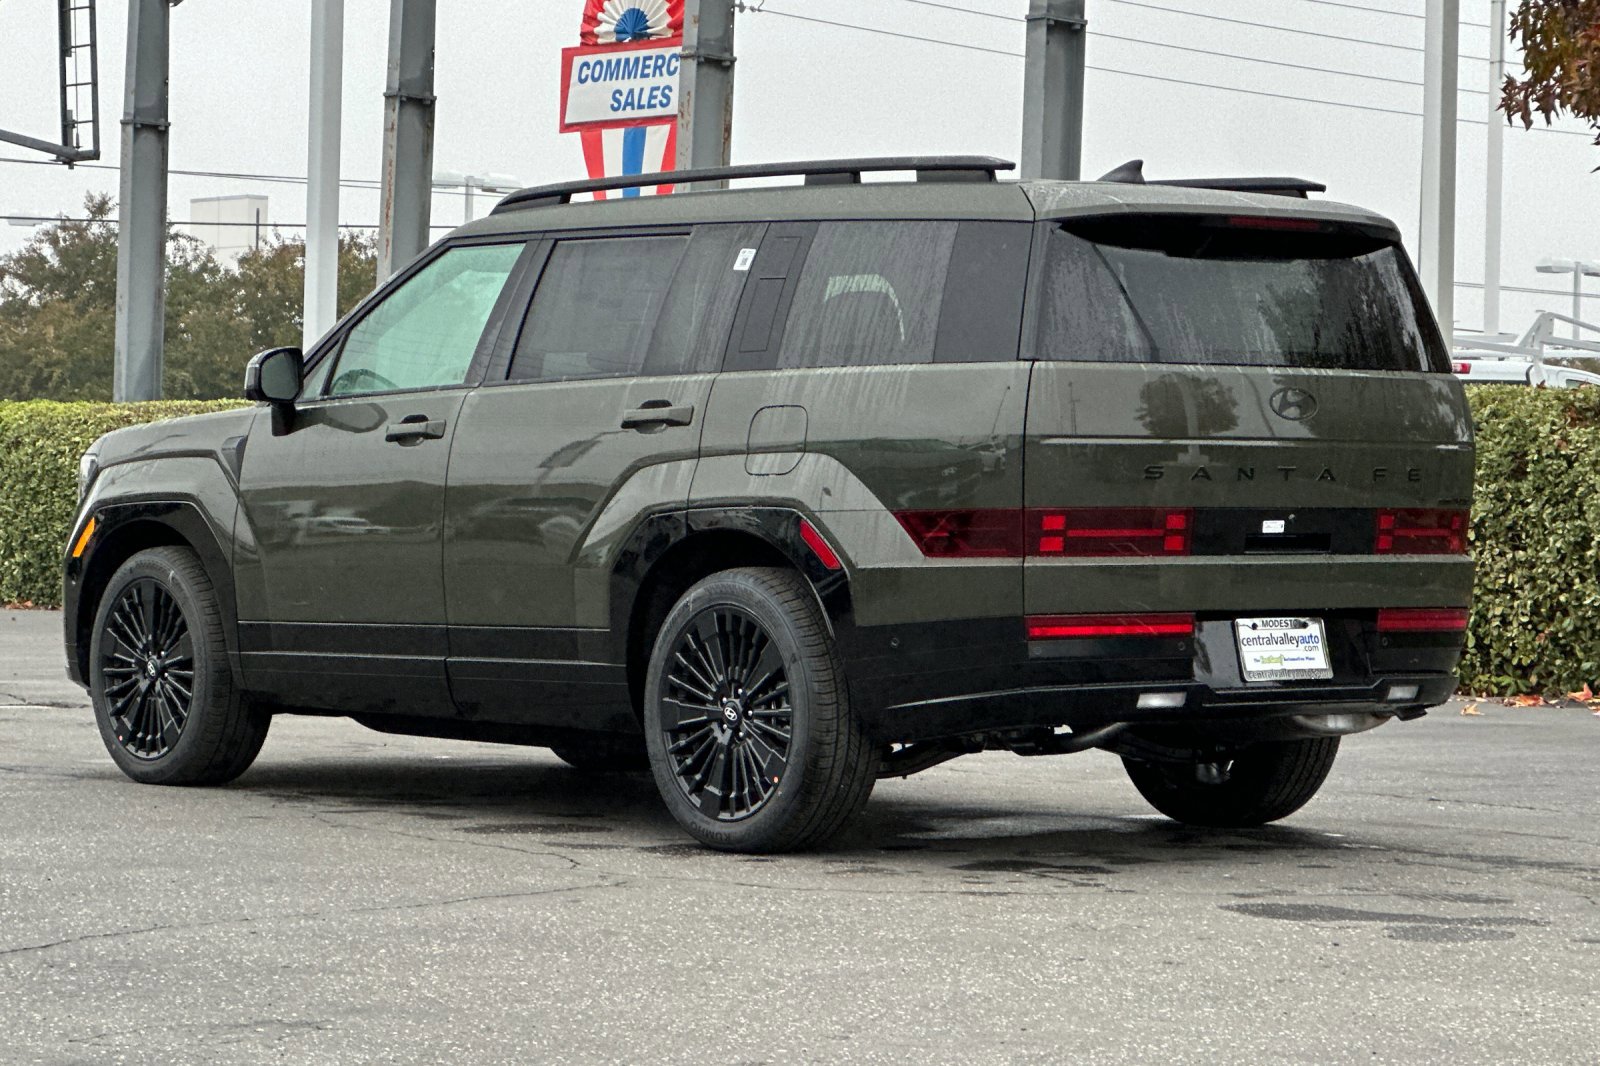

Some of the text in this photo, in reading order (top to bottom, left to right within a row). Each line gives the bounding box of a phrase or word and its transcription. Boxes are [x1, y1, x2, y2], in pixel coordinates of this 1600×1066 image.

[577, 52, 680, 85] COMMERC
[610, 84, 673, 112] SALES
[1143, 465, 1422, 482] SANTA FE
[1241, 632, 1320, 648] centralvalleyauto
[690, 820, 731, 841] KUMHO
